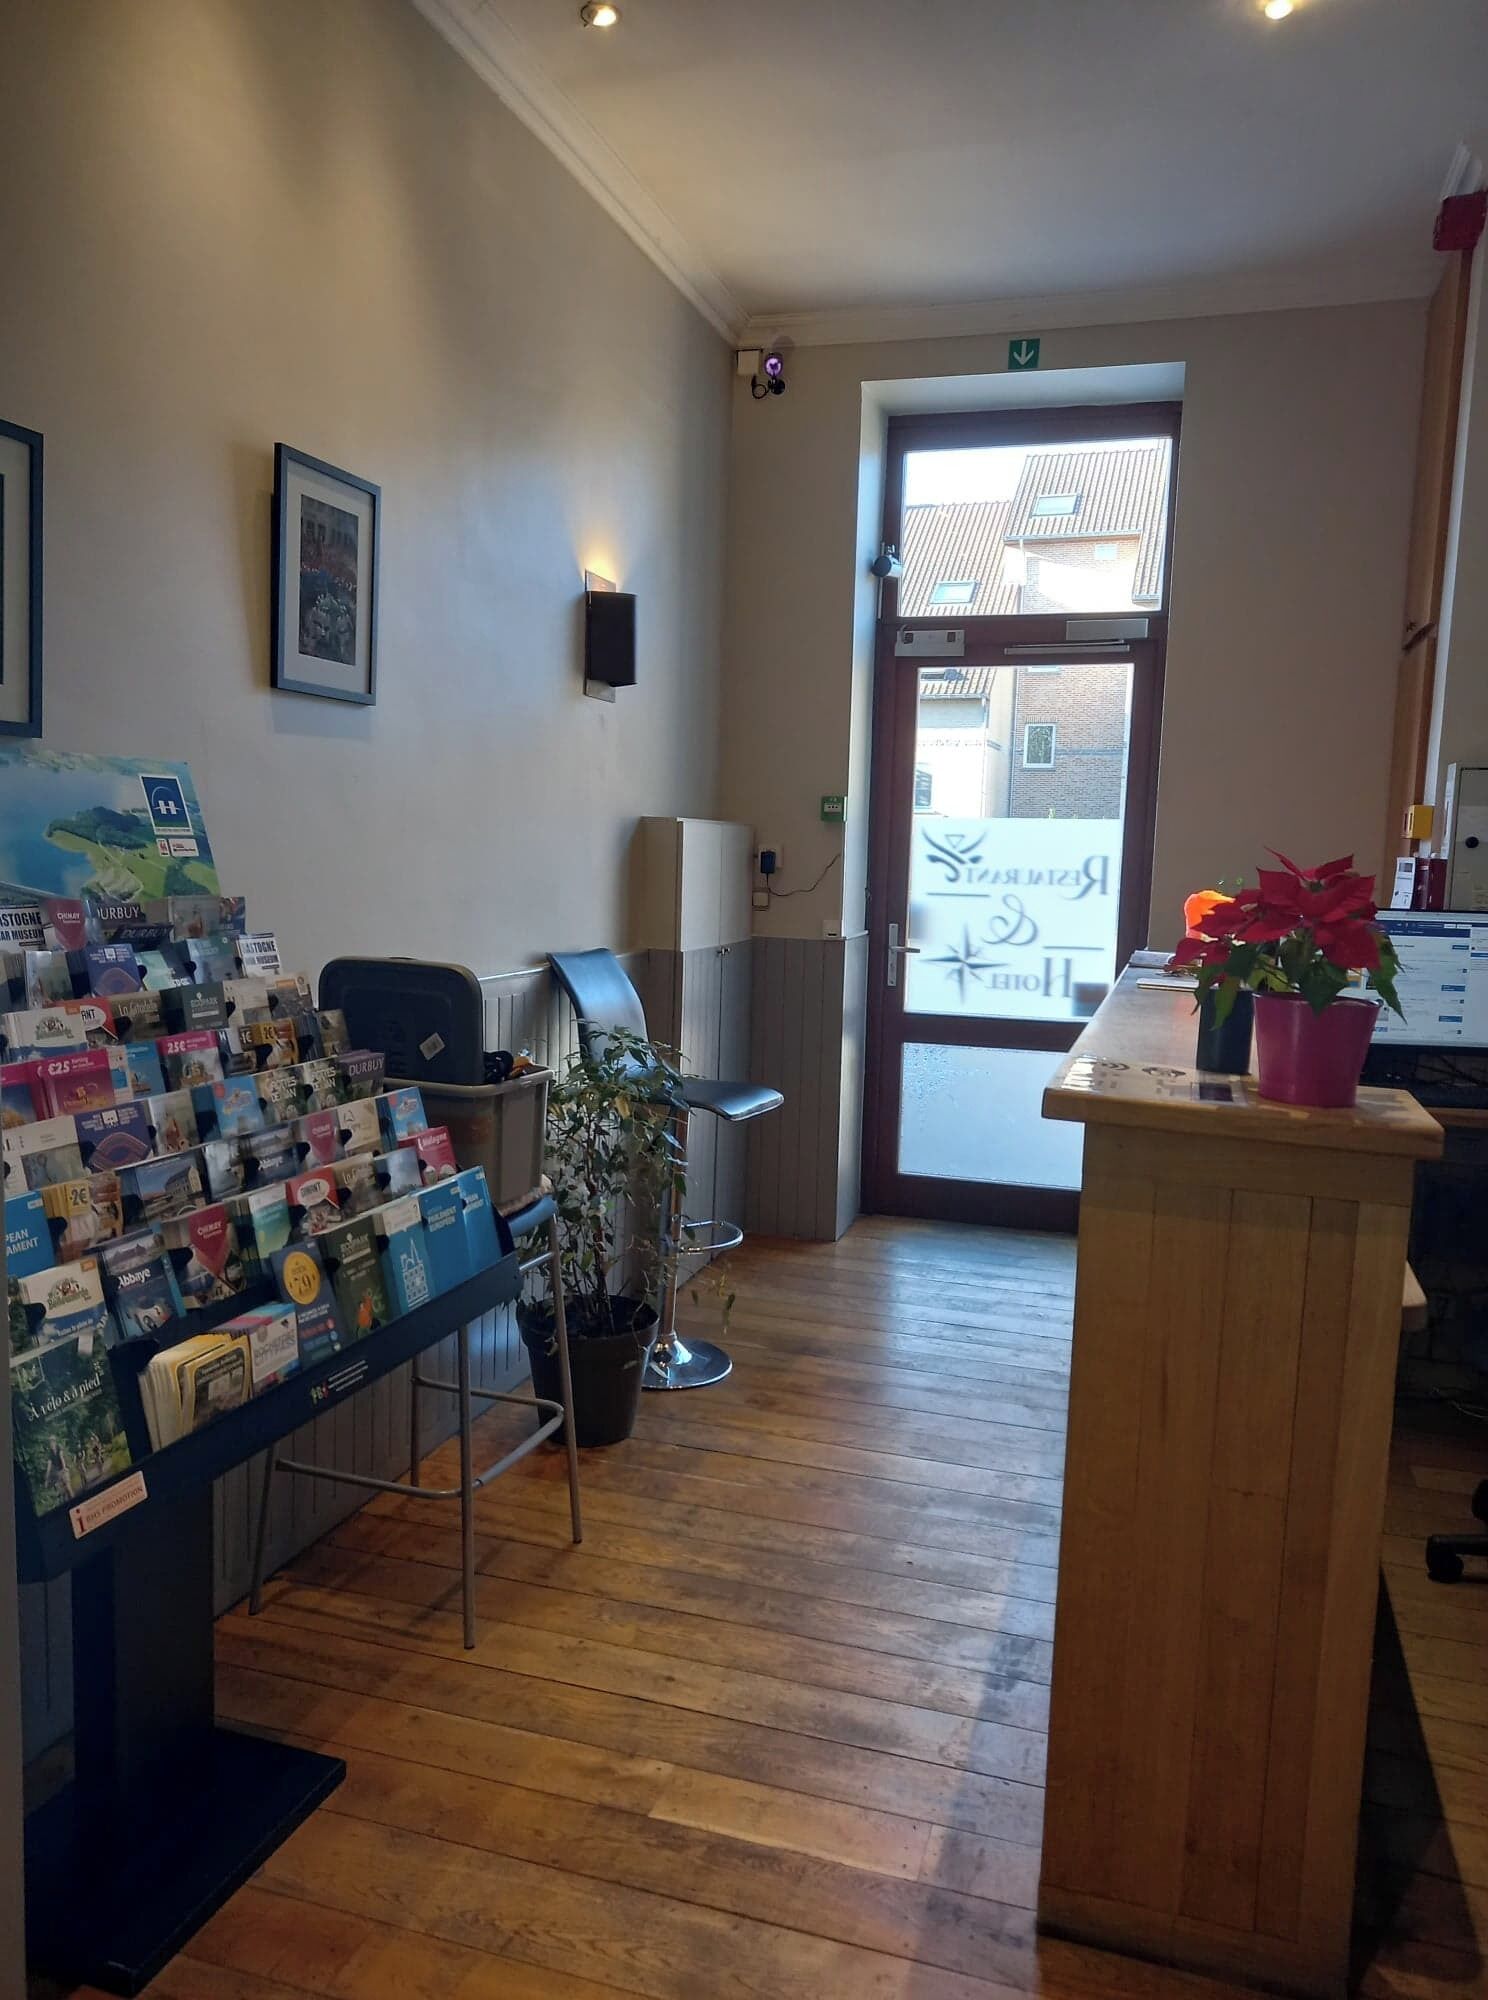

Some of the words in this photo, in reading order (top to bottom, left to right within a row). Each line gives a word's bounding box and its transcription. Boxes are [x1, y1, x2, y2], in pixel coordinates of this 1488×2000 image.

[98, 906, 140, 920] URBUY
[0, 930, 12, 942] AR
[117, 1267, 151, 1289] Abbaye
